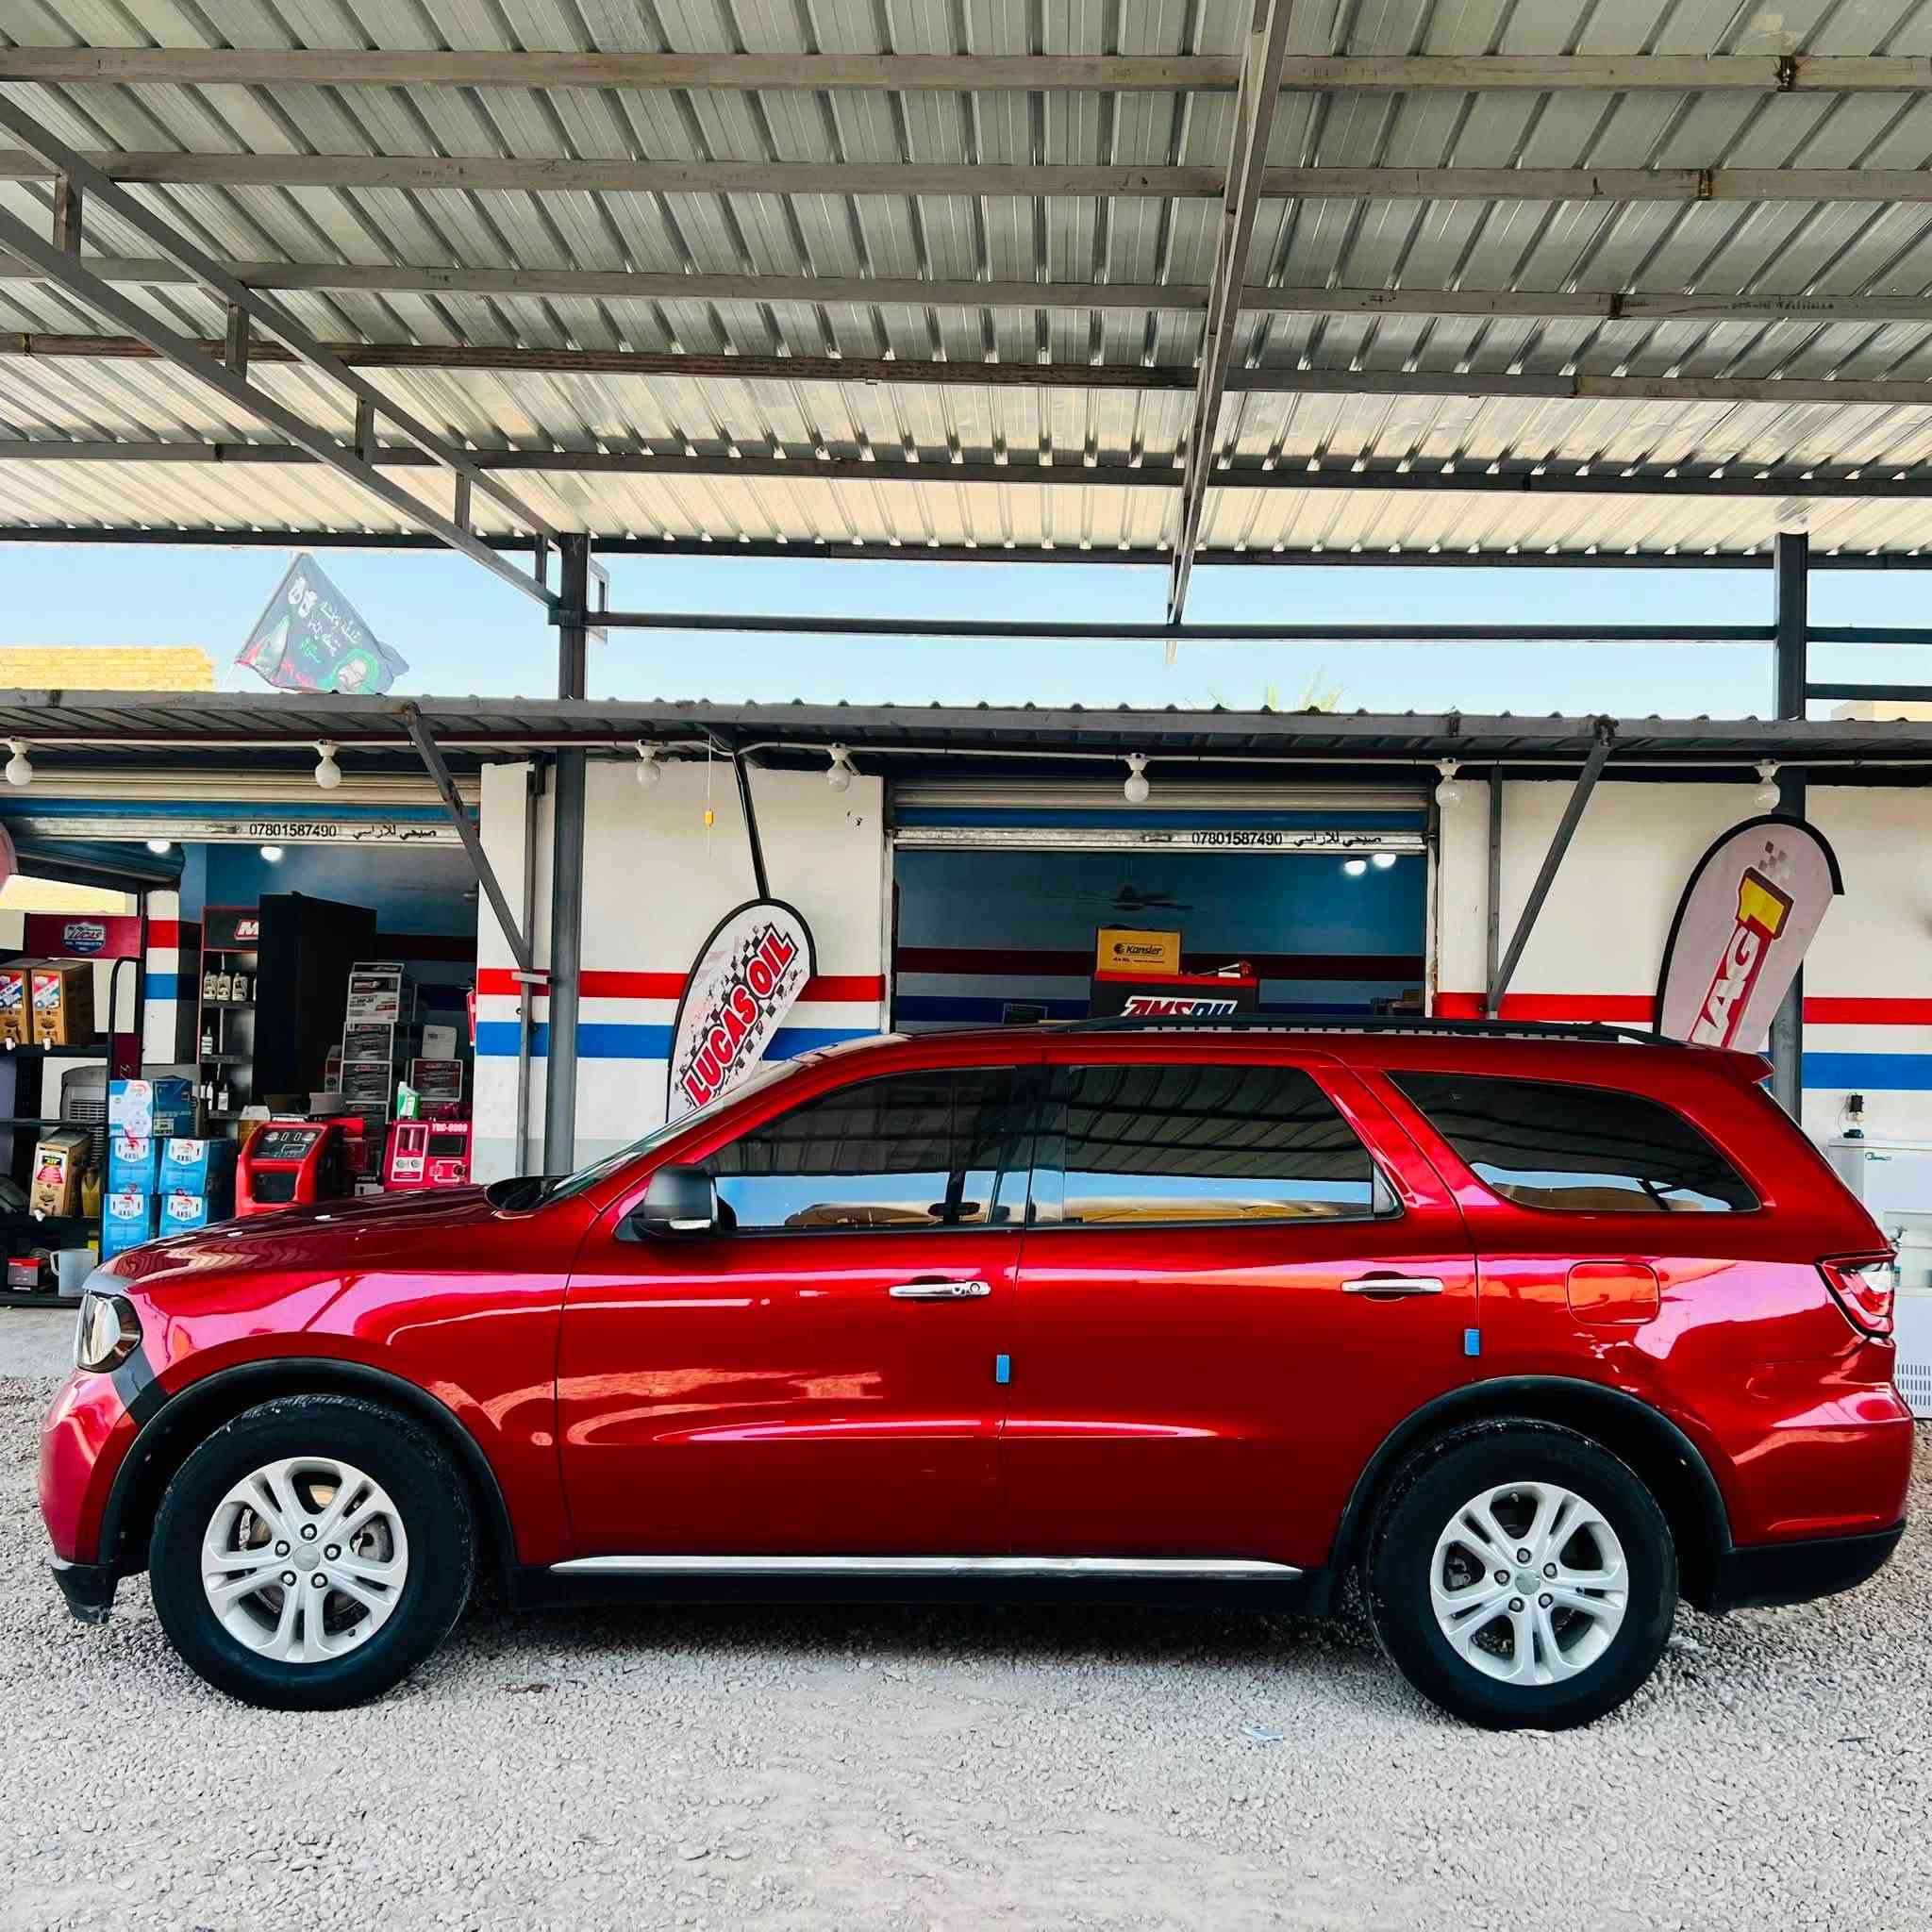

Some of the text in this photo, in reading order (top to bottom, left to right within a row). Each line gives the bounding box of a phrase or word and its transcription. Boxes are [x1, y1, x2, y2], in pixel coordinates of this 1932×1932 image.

[249, 824, 337, 838] 07801587490
[1191, 831, 1283, 846] 07801587490
[1125, 943, 1163, 956] Kansler
[682, 928, 794, 1108] LUCAS OIL
